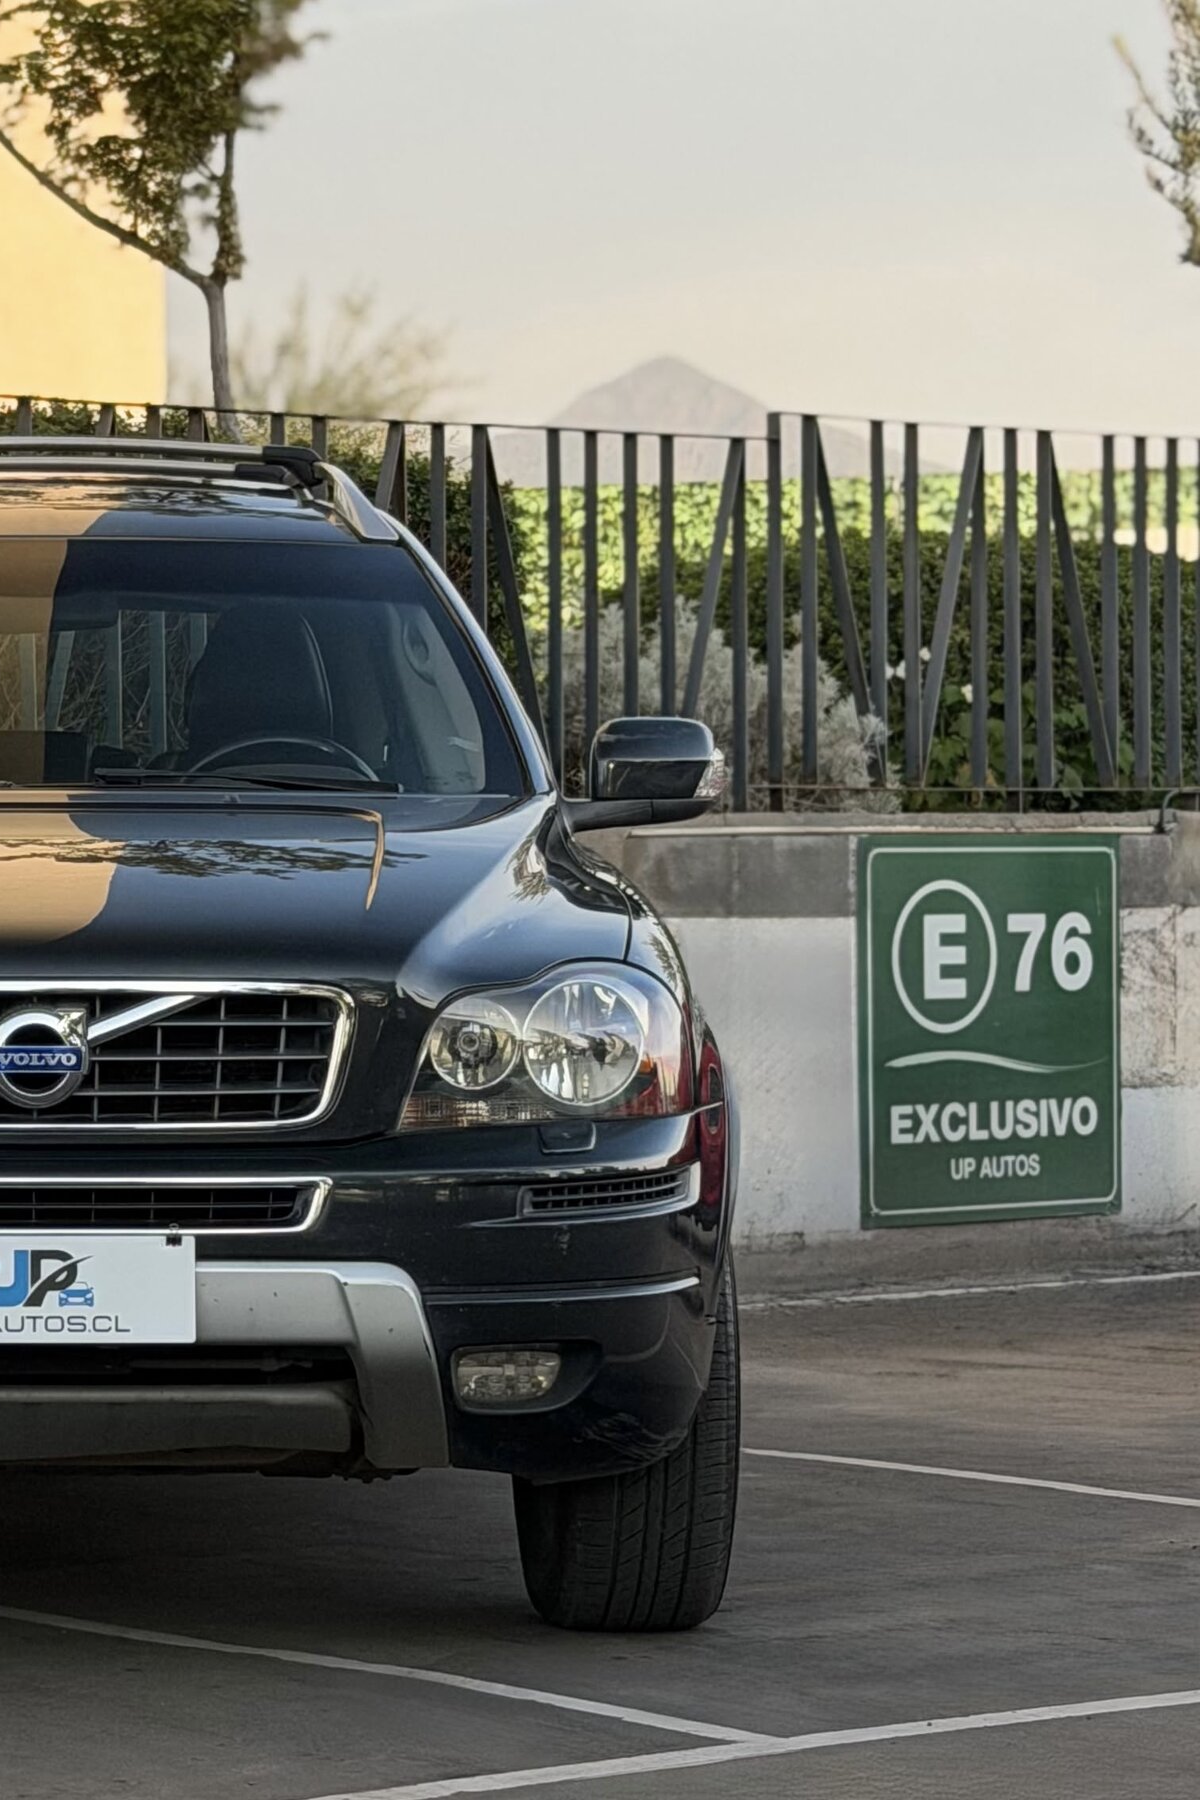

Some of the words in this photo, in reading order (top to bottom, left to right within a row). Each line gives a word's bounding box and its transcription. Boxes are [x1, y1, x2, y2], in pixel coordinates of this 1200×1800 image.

[923, 913, 967, 1000] E
[1006, 911, 1093, 992] 76
[890, 1096, 1098, 1145] EXCLUSIVO
[950, 1157, 976, 1181] UP
[979, 1153, 1041, 1179] AUTOS
